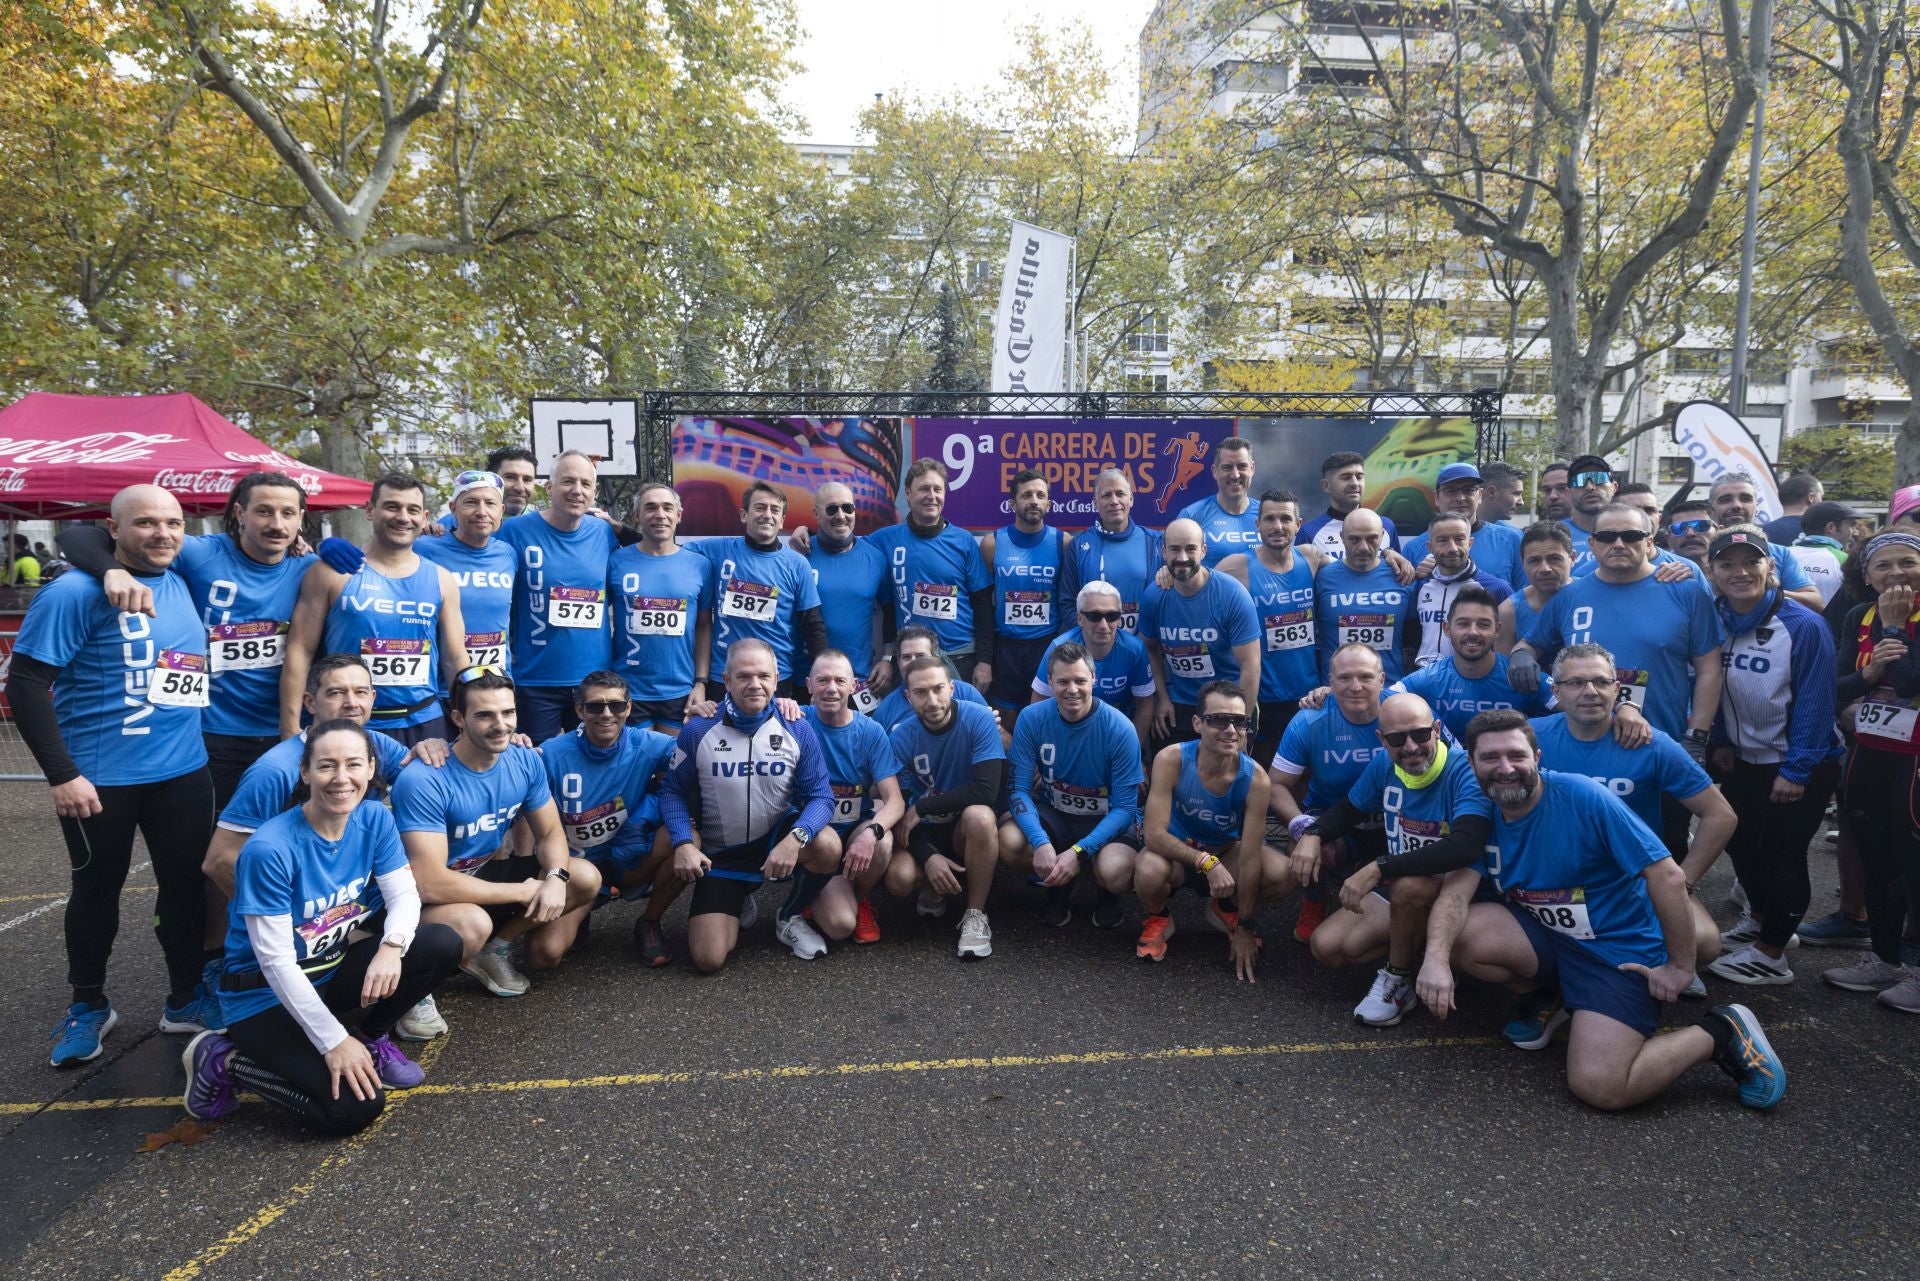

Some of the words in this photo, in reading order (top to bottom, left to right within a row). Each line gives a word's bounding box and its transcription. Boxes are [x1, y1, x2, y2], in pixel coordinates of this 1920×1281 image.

[942, 433, 994, 492] 9ª
[1000, 432, 1120, 459] CARRERA
[1125, 432, 1157, 459] DE
[153, 468, 241, 494] Coca-Cola
[1001, 462, 1155, 493] EPREAS
[1066, 499, 1099, 513] Cast
[1204, 531, 1263, 543] IVEC
[997, 565, 1056, 577] IVECO
[1803, 566, 1830, 575] ASA
[451, 571, 512, 589] VECO
[525, 545, 547, 646] IVECO
[731, 594, 769, 613] 587
[919, 595, 952, 613] 612
[1330, 591, 1402, 608] IVECO
[342, 595, 436, 617] IVECO
[558, 602, 596, 621] 573
[1012, 604, 1043, 618] 564
[640, 611, 679, 628] 580
[1420, 610, 1447, 623] IVE
[1159, 626, 1219, 642] IVECO
[1274, 624, 1308, 643] 563
[1346, 628, 1385, 643] 598
[222, 638, 277, 661] 585
[371, 657, 421, 676] 567
[1171, 657, 1205, 672] 595
[1721, 652, 1771, 674] ECO
[118, 611, 154, 735] IVECO
[162, 672, 203, 696] 584
[1858, 703, 1901, 726] 957
[1324, 747, 1386, 764] IVE
[712, 761, 786, 778] IVECO
[1061, 793, 1099, 811] 593
[575, 816, 620, 841] 588
[303, 870, 372, 919] IVEC
